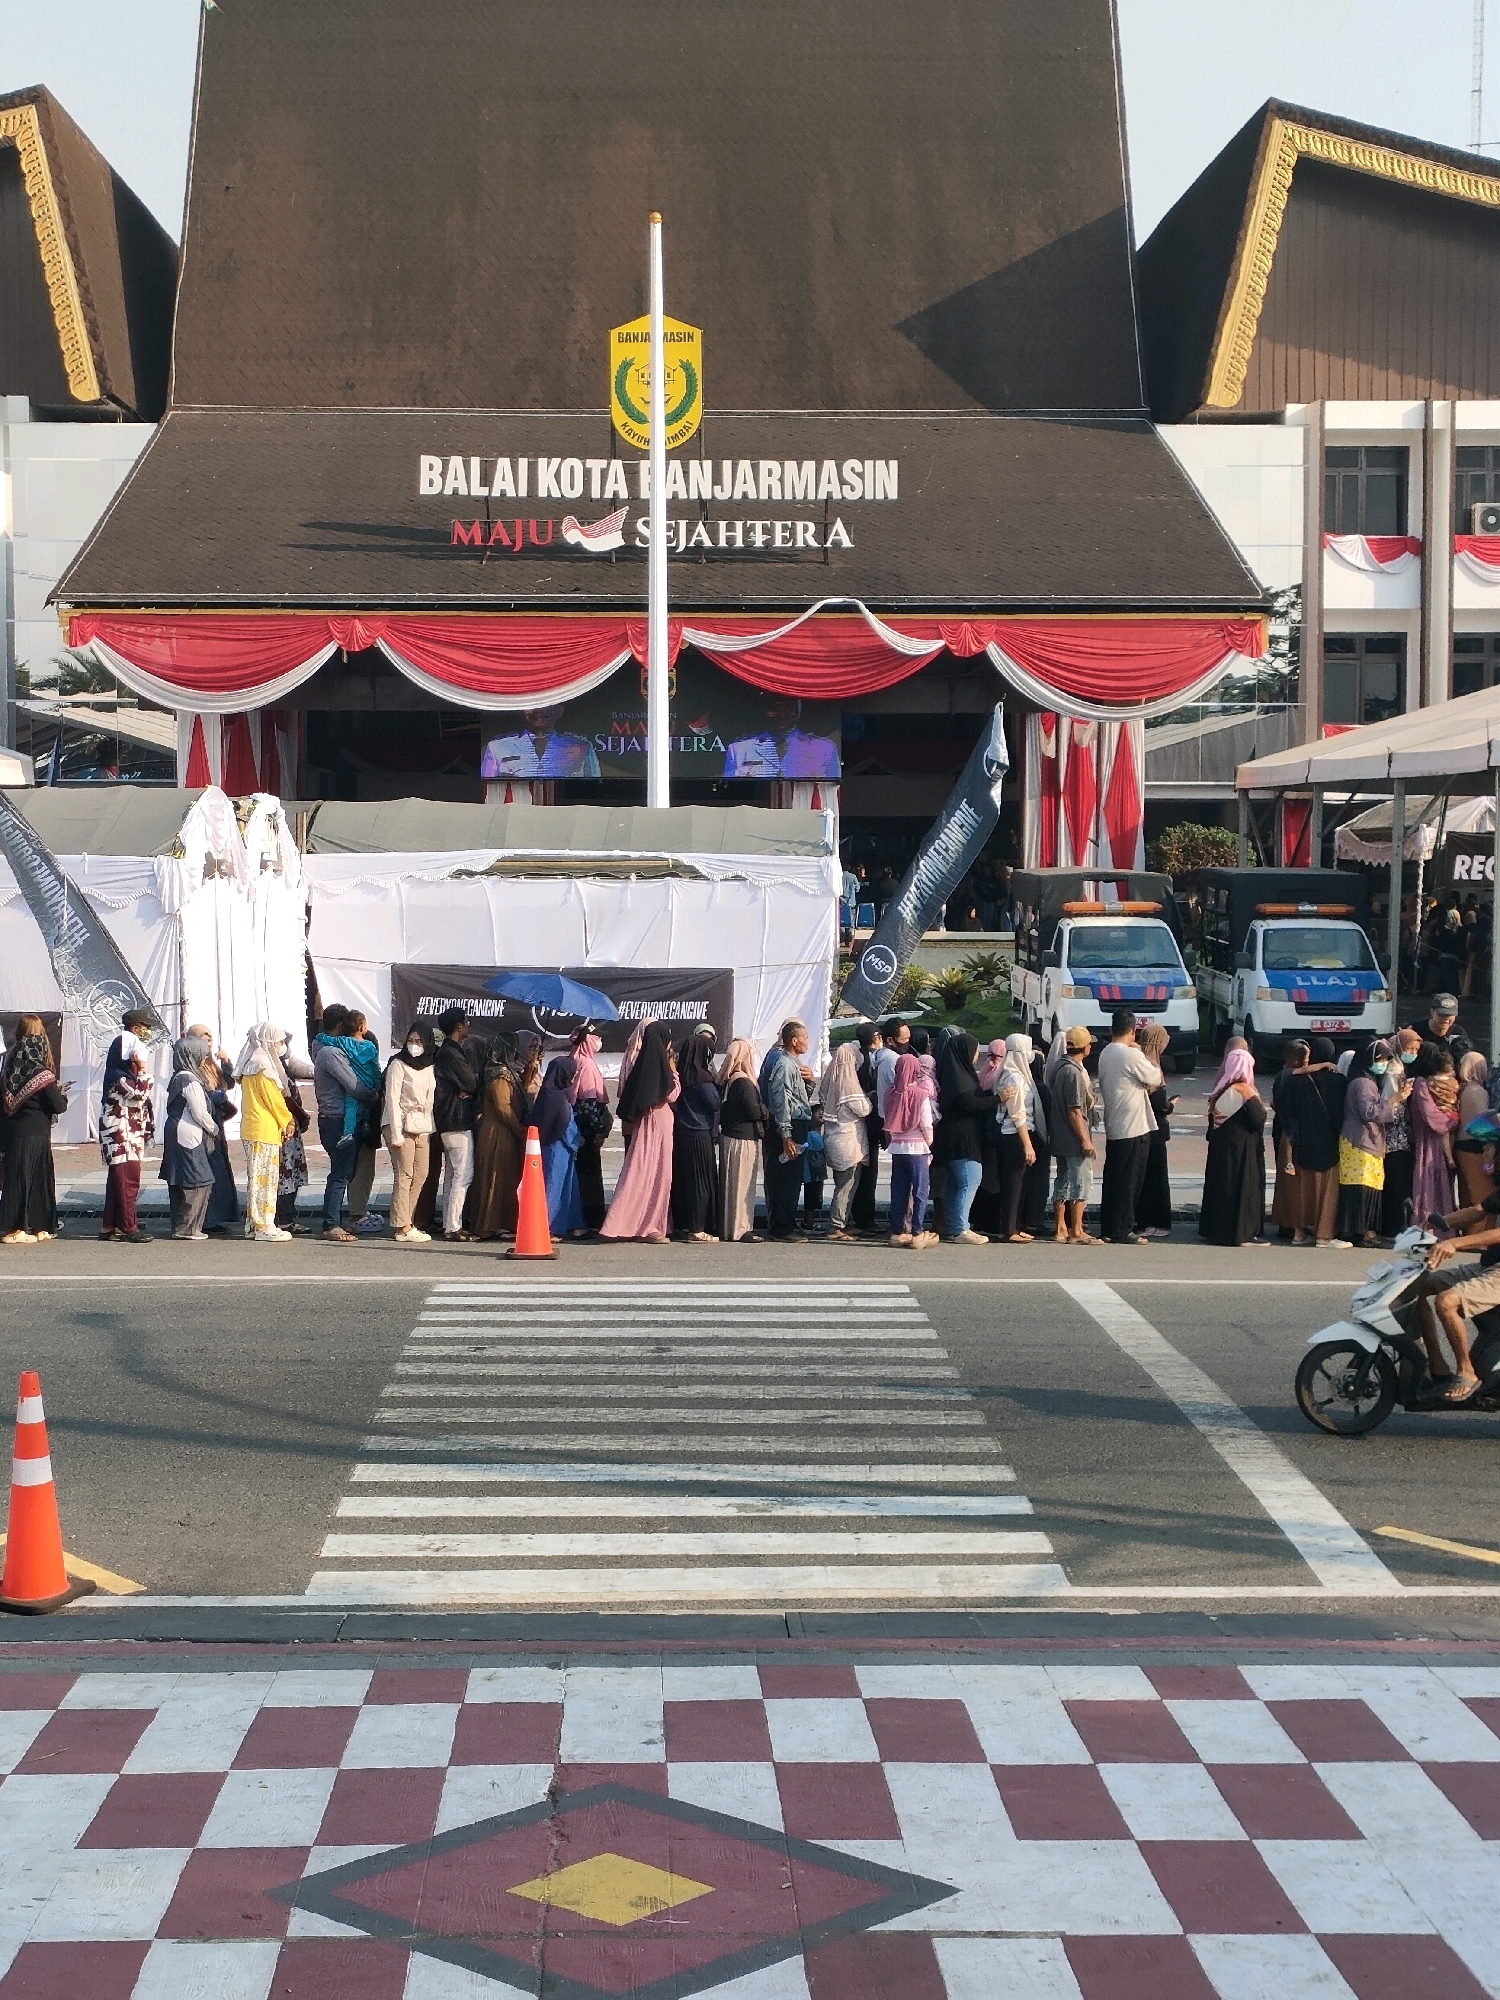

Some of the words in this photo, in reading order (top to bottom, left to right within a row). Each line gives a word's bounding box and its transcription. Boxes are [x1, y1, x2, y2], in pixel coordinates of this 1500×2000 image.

[617, 331, 695, 344] BANJAMASIN
[620, 421, 651, 447] KAYUH
[664, 420, 694, 447] IMBAI
[419, 454, 528, 497] BALAI
[537, 457, 629, 498] KOTA
[452, 518, 553, 552] MAJU
[612, 711, 677, 720] BANJARN
[594, 733, 727, 756] SEJATERA
[897, 798, 983, 924] #EVERYONECANGIVE
[865, 953, 893, 974] MSP
[1296, 976, 1357, 987] LLAJ
[618, 1001, 710, 1020] #EVERYONECANGIVE
